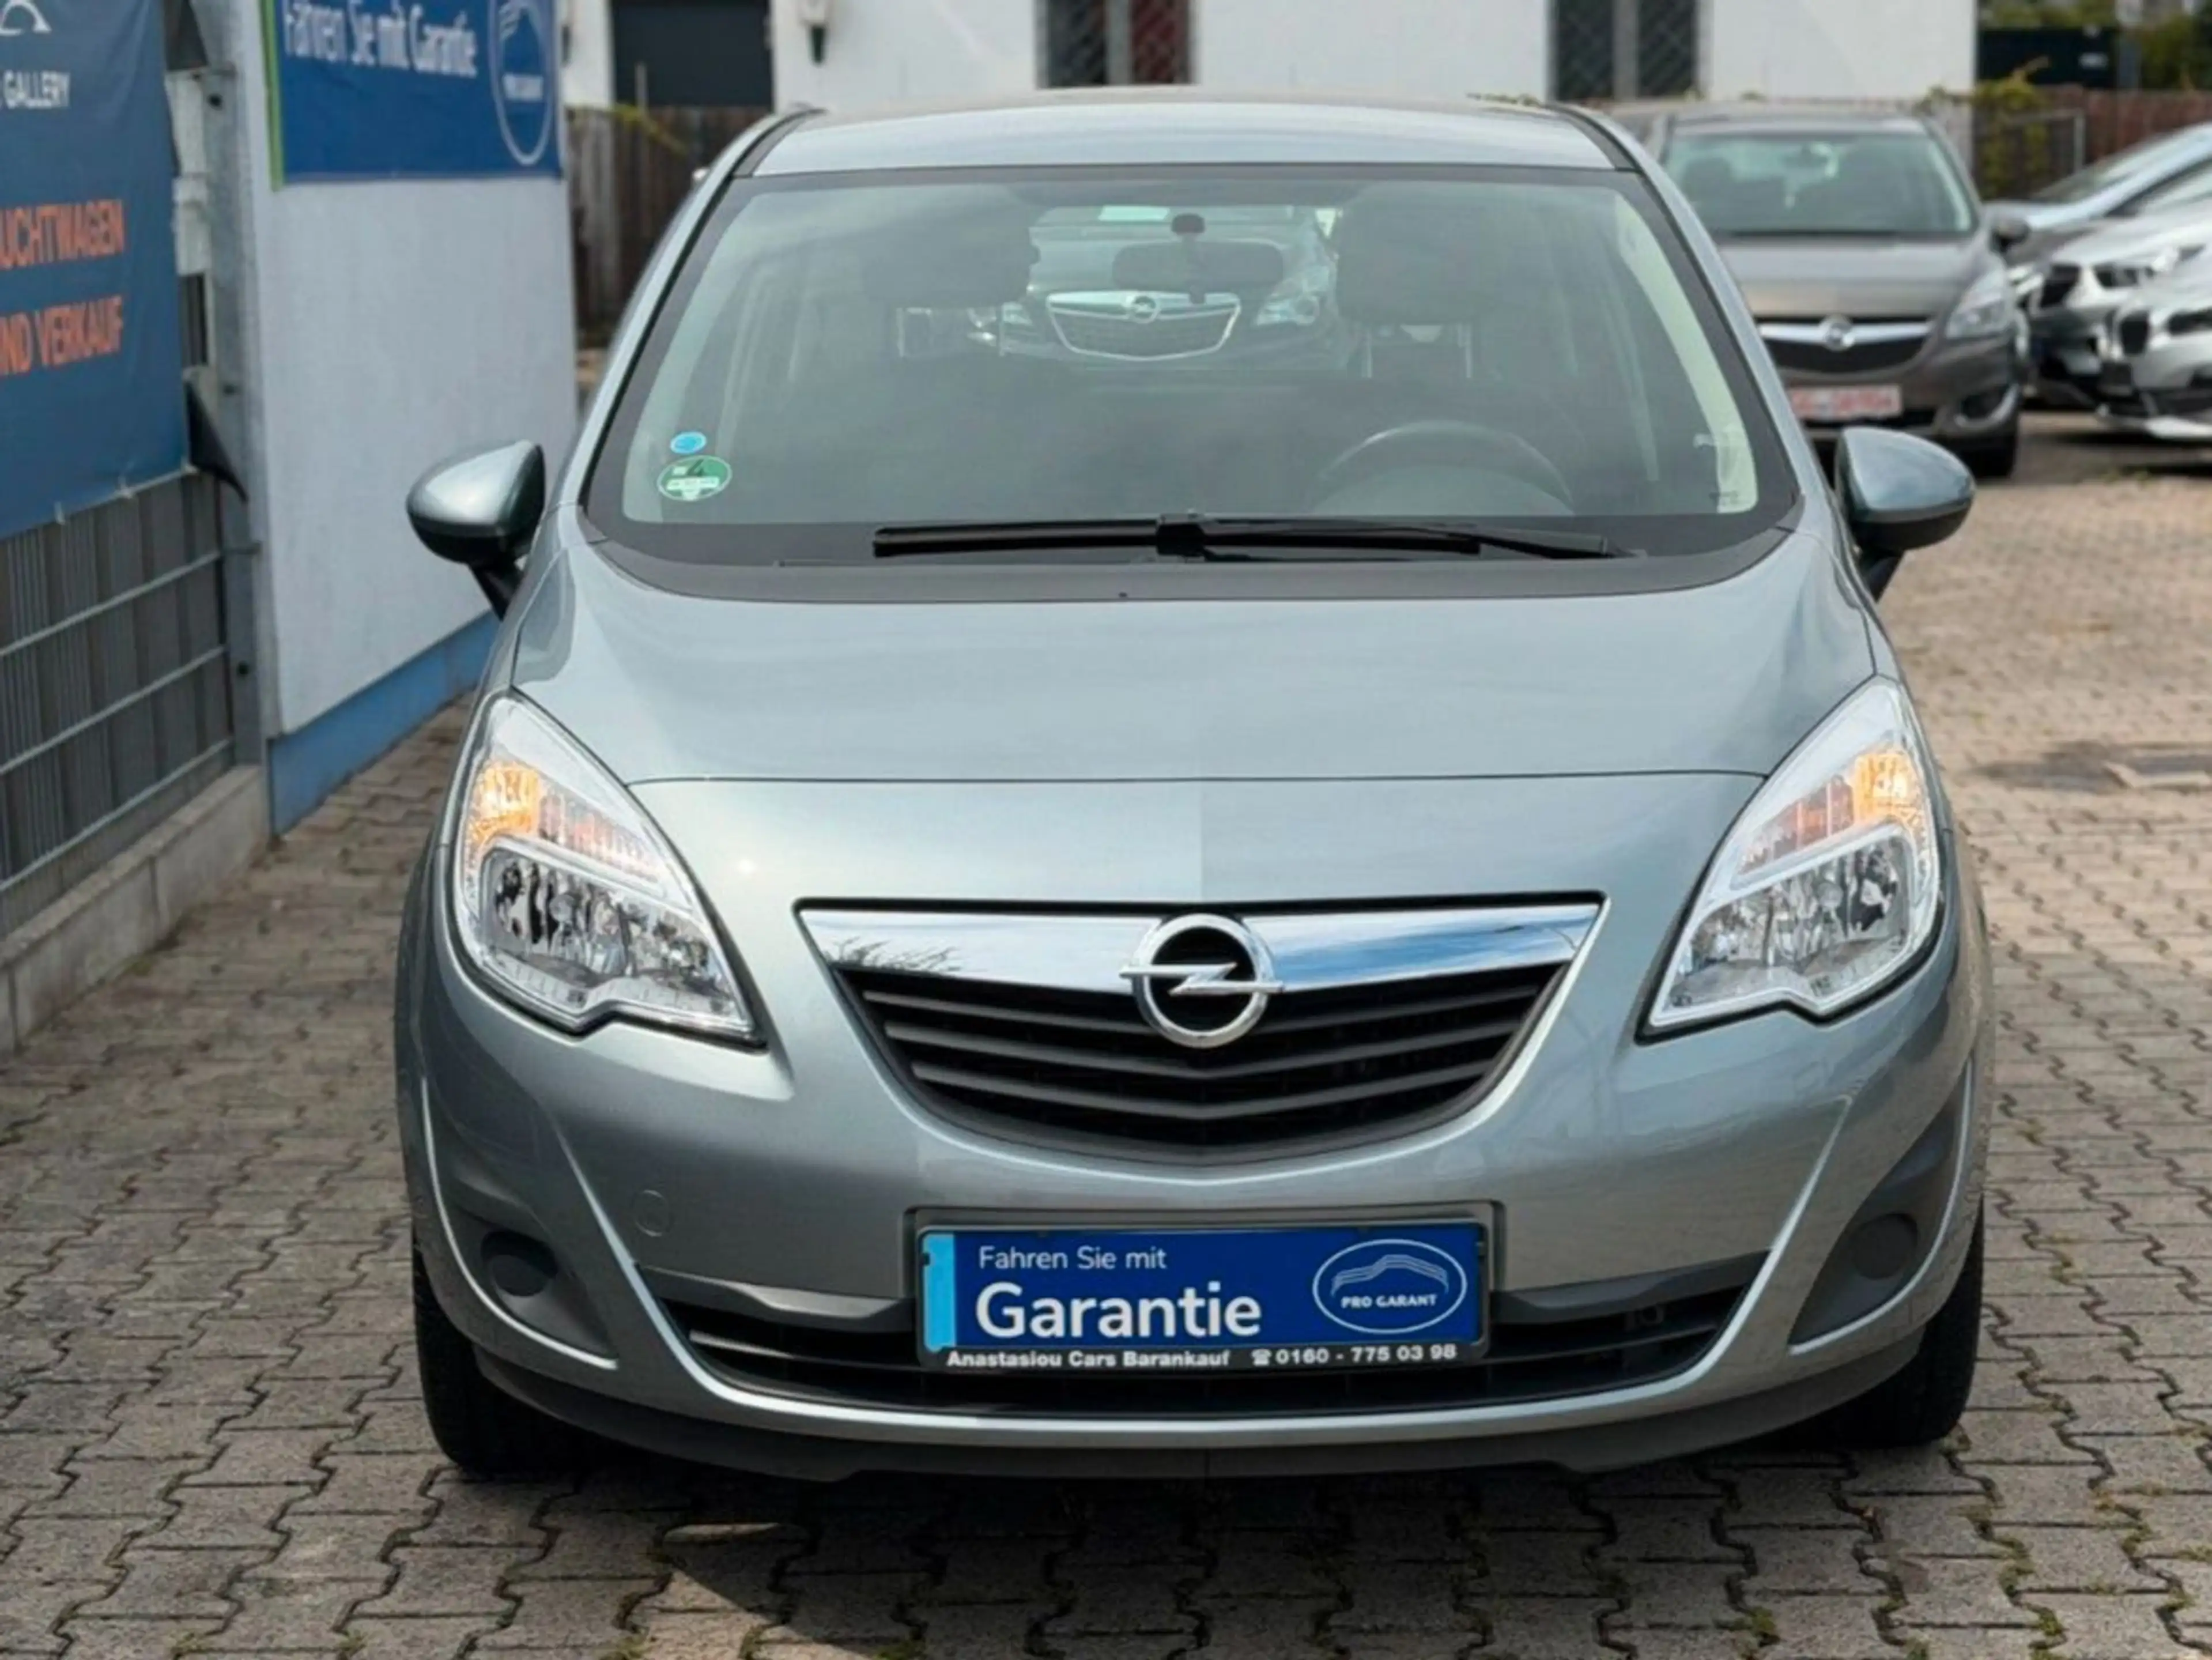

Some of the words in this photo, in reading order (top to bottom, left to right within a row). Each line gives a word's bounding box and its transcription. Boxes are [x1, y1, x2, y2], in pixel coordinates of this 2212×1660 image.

[410, 3, 477, 78] Garantie
[3, 69, 70, 110] GALLERY
[33, 295, 123, 367] VERKAUF
[979, 1246, 1068, 1269] Fahren
[1077, 1246, 1117, 1269] Sie
[1126, 1246, 1167, 1269] mit
[975, 1280, 1262, 1338] Garantie
[1341, 1295, 1372, 1309] PRO
[1376, 1293, 1438, 1308] GARANT
[946, 1350, 1062, 1368] Anastasiou
[1069, 1350, 1116, 1368] Cars
[1123, 1349, 1230, 1367] Barankauf
[1275, 1348, 1330, 1365] 0160
[1350, 1346, 1391, 1363] 775
[1396, 1345, 1424, 1361] 03
[1430, 1343, 1458, 1360] 98
